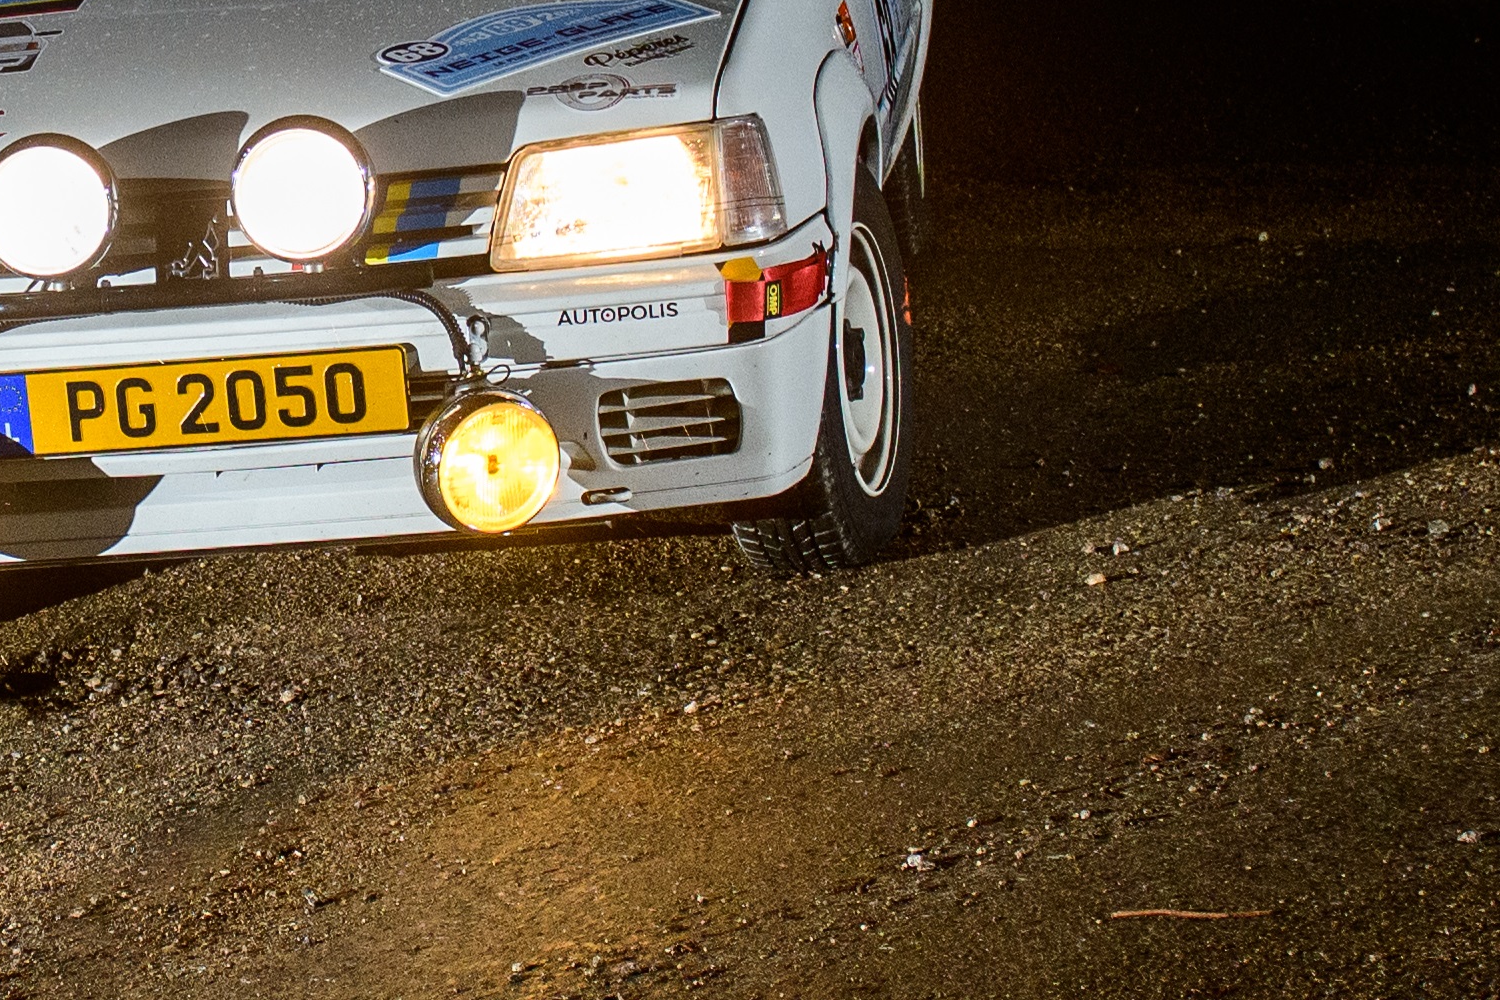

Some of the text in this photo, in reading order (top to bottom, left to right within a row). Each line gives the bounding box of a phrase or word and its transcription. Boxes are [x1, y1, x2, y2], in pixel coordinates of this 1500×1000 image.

[391, 41, 447, 63] 68
[423, 37, 549, 78] NEIGE
[554, 3, 676, 38] GLACE
[768, 284, 778, 316] OMP
[557, 302, 679, 327] AUTOPOLIS
[66, 363, 367, 442] PG 2050
[5, 422, 20, 443] L
